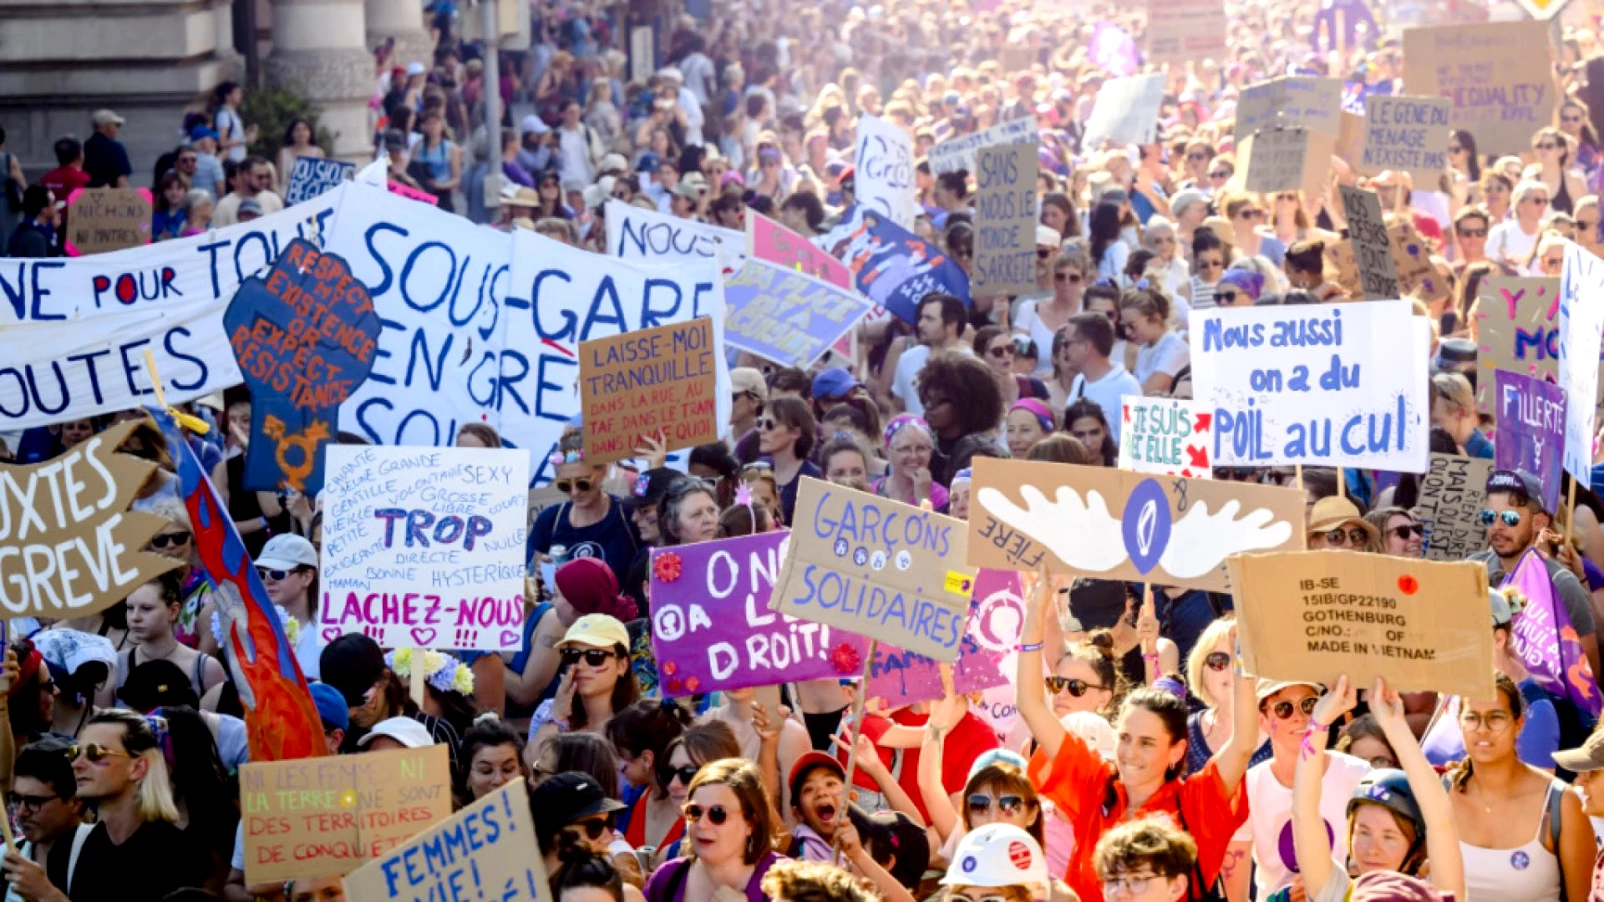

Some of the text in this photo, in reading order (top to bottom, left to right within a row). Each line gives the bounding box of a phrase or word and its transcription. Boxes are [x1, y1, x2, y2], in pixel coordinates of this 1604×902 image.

[1370, 101, 1392, 124] LE
[980, 151, 1018, 188] SANS
[980, 190, 1034, 219] NOUS LE
[93, 267, 183, 308] POUR
[287, 243, 374, 314] RESPECT
[265, 269, 376, 362] EXISTENCE
[1203, 309, 1343, 351] Nous aussi
[251, 317, 343, 381] EXPECT
[288, 318, 320, 350] OR
[593, 324, 707, 368] LAISSE-MOI
[230, 325, 354, 411] RESISTANCE
[587, 351, 713, 396] TRANQUILLE
[1250, 369, 1283, 393] on
[1320, 354, 1360, 391] du
[590, 398, 714, 435] TAF DANS LE TRAIN
[591, 396, 625, 417] DANS
[631, 394, 648, 409] LA
[686, 381, 704, 397] AU
[592, 435, 624, 454] DANS
[675, 418, 710, 440] QUOI
[1133, 405, 1148, 434] JE
[1284, 417, 1332, 458] au
[1340, 394, 1406, 456] cul
[378, 452, 441, 476] GRANDE
[1146, 435, 1182, 465] ELLE
[461, 464, 513, 484] SEXY
[1441, 459, 1471, 504] MAIS
[331, 478, 397, 518] GENTILLE
[420, 486, 493, 506] GROSSE
[432, 502, 476, 515] LIBRE
[324, 505, 373, 536] VIEILLE
[374, 507, 493, 552] TROP
[814, 491, 952, 559] GARÇONS
[327, 522, 369, 558] PETITE
[394, 550, 461, 565] DIRECTE
[484, 528, 527, 554] NULLE
[0, 513, 139, 613] GREVE
[366, 567, 418, 581] BONNE
[432, 561, 526, 588] HYSTERIQUE
[328, 579, 371, 592] MAMAN
[1300, 577, 1341, 591] IB-SE
[321, 591, 525, 629] LACHEZ-NOUS
[793, 564, 962, 648] SOLIDAIRES
[1303, 609, 1407, 627] GOTHENBURG
[1307, 641, 1351, 653] MADE
[1354, 643, 1368, 655] IN
[1386, 630, 1405, 642] OF
[245, 770, 264, 791] NI
[276, 767, 308, 790] LES
[400, 756, 425, 780] NI
[246, 783, 444, 813] LA TERRE NE SONT
[249, 806, 433, 836] DES TERRITOIRES
[256, 844, 286, 865] DE
